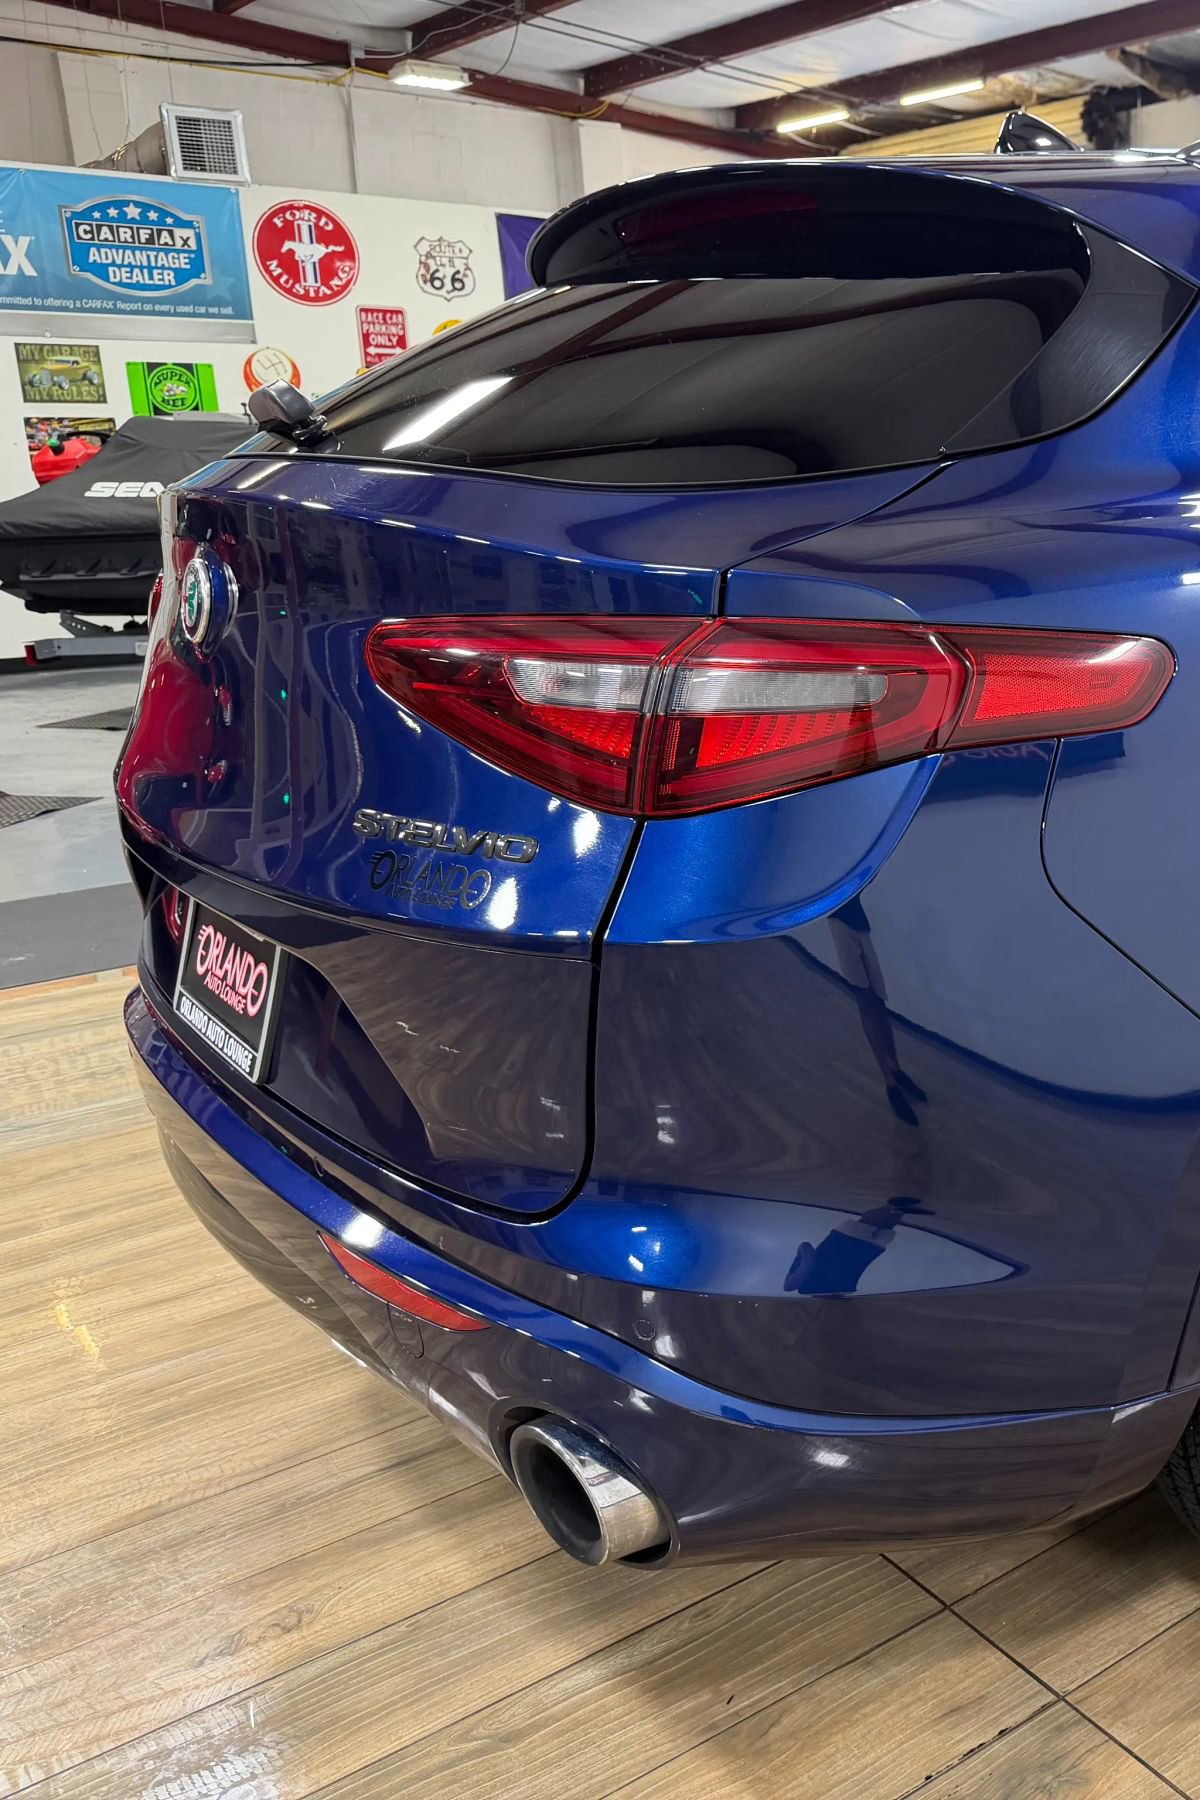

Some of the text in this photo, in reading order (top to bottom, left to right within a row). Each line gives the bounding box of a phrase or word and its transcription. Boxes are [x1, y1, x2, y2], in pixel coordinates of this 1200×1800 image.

[273, 209, 334, 231] FORD
[78, 224, 192, 248] CARFAX
[89, 247, 191, 268] ADVANTAGE
[108, 267, 176, 286] DEALER
[266, 259, 356, 298] MUSTANG
[33, 297, 43, 306] to
[44, 297, 74, 309] offering
[75, 300, 81, 308] a
[117, 301, 142, 311] Report
[143, 303, 153, 311] on
[154, 303, 174, 313] every
[176, 304, 193, 314] used
[208, 306, 218, 314] we
[361, 311, 403, 324] RACE CAR
[363, 323, 404, 336] PARKING
[369, 334, 399, 346] ONLY
[19, 344, 99, 361] MY GARAGE
[155, 371, 191, 387] SUPER
[25, 385, 104, 401] MY RULES!
[161, 397, 187, 408] BEE
[353, 808, 540, 864] STELVIO
[370, 850, 492, 909] ORLANDO
[197, 924, 268, 1017] ORLANDO
[204, 973, 247, 1014] AUTO LOUNGE
[180, 996, 253, 1073] ORLANDO AUTO LOUNGE
